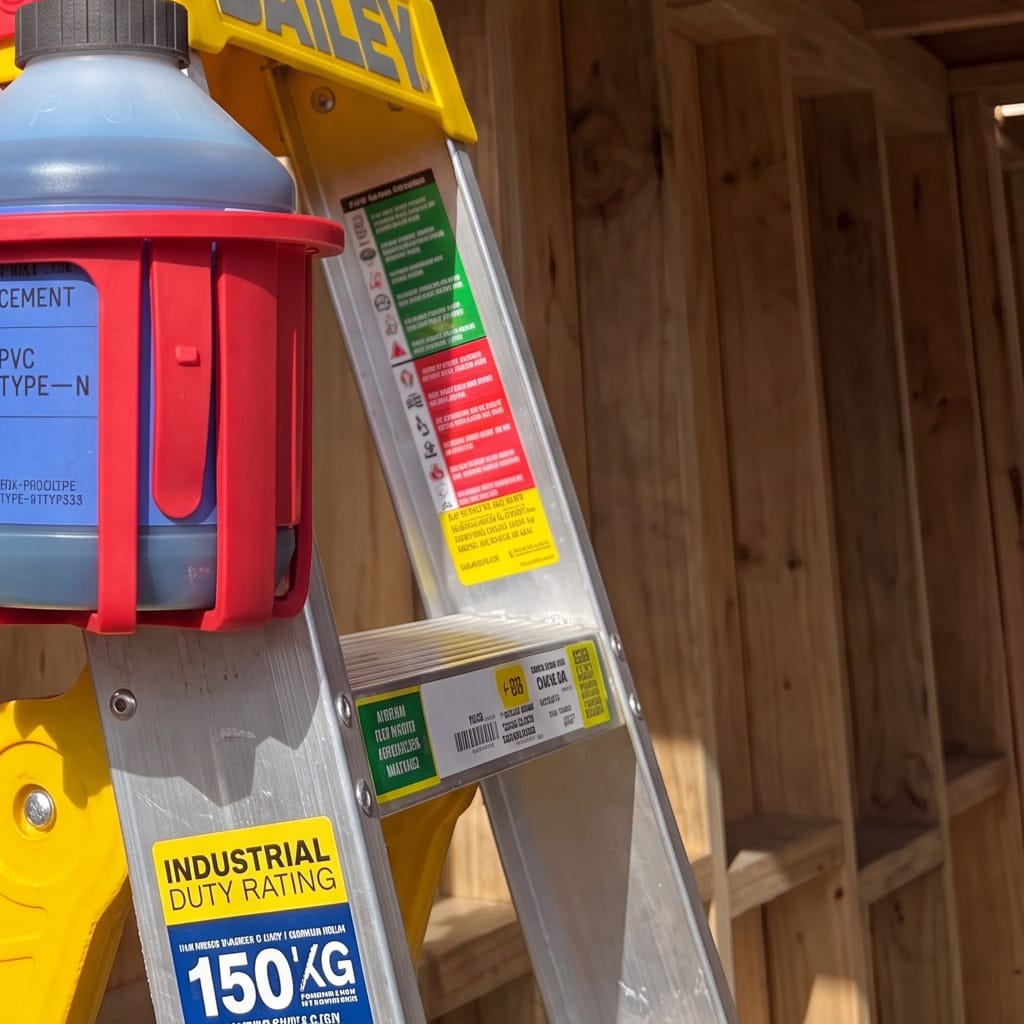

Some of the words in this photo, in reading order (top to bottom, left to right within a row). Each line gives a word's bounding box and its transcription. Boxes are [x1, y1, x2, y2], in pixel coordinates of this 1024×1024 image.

[163, 837, 331, 883] INDUSTRIAL
[169, 877, 233, 912] DUTY
[243, 867, 337, 902] RATING
